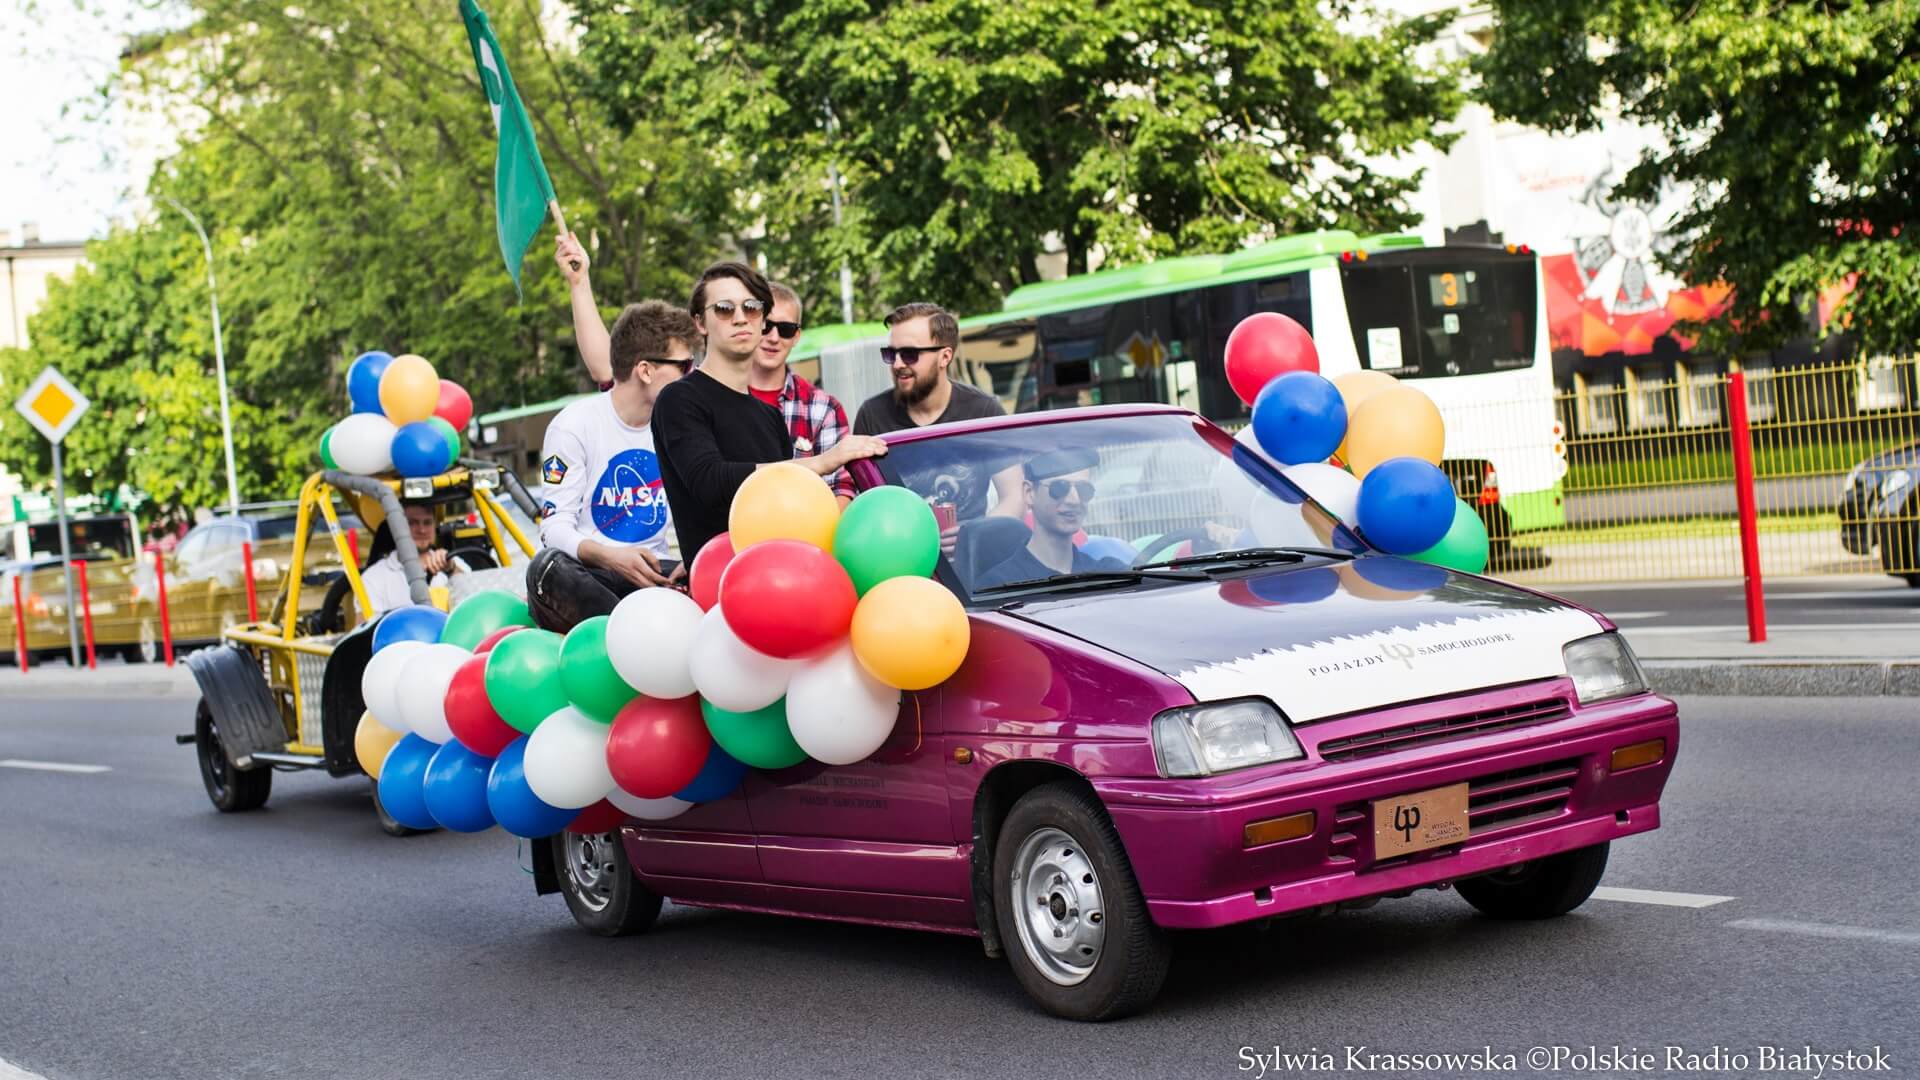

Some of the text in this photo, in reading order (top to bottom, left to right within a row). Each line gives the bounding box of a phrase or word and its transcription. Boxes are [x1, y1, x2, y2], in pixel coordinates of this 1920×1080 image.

[1440, 272, 1459, 306] 3
[598, 486, 667, 507] NASA
[1308, 632, 1515, 677] POJAZDY SAMOCHODOWE
